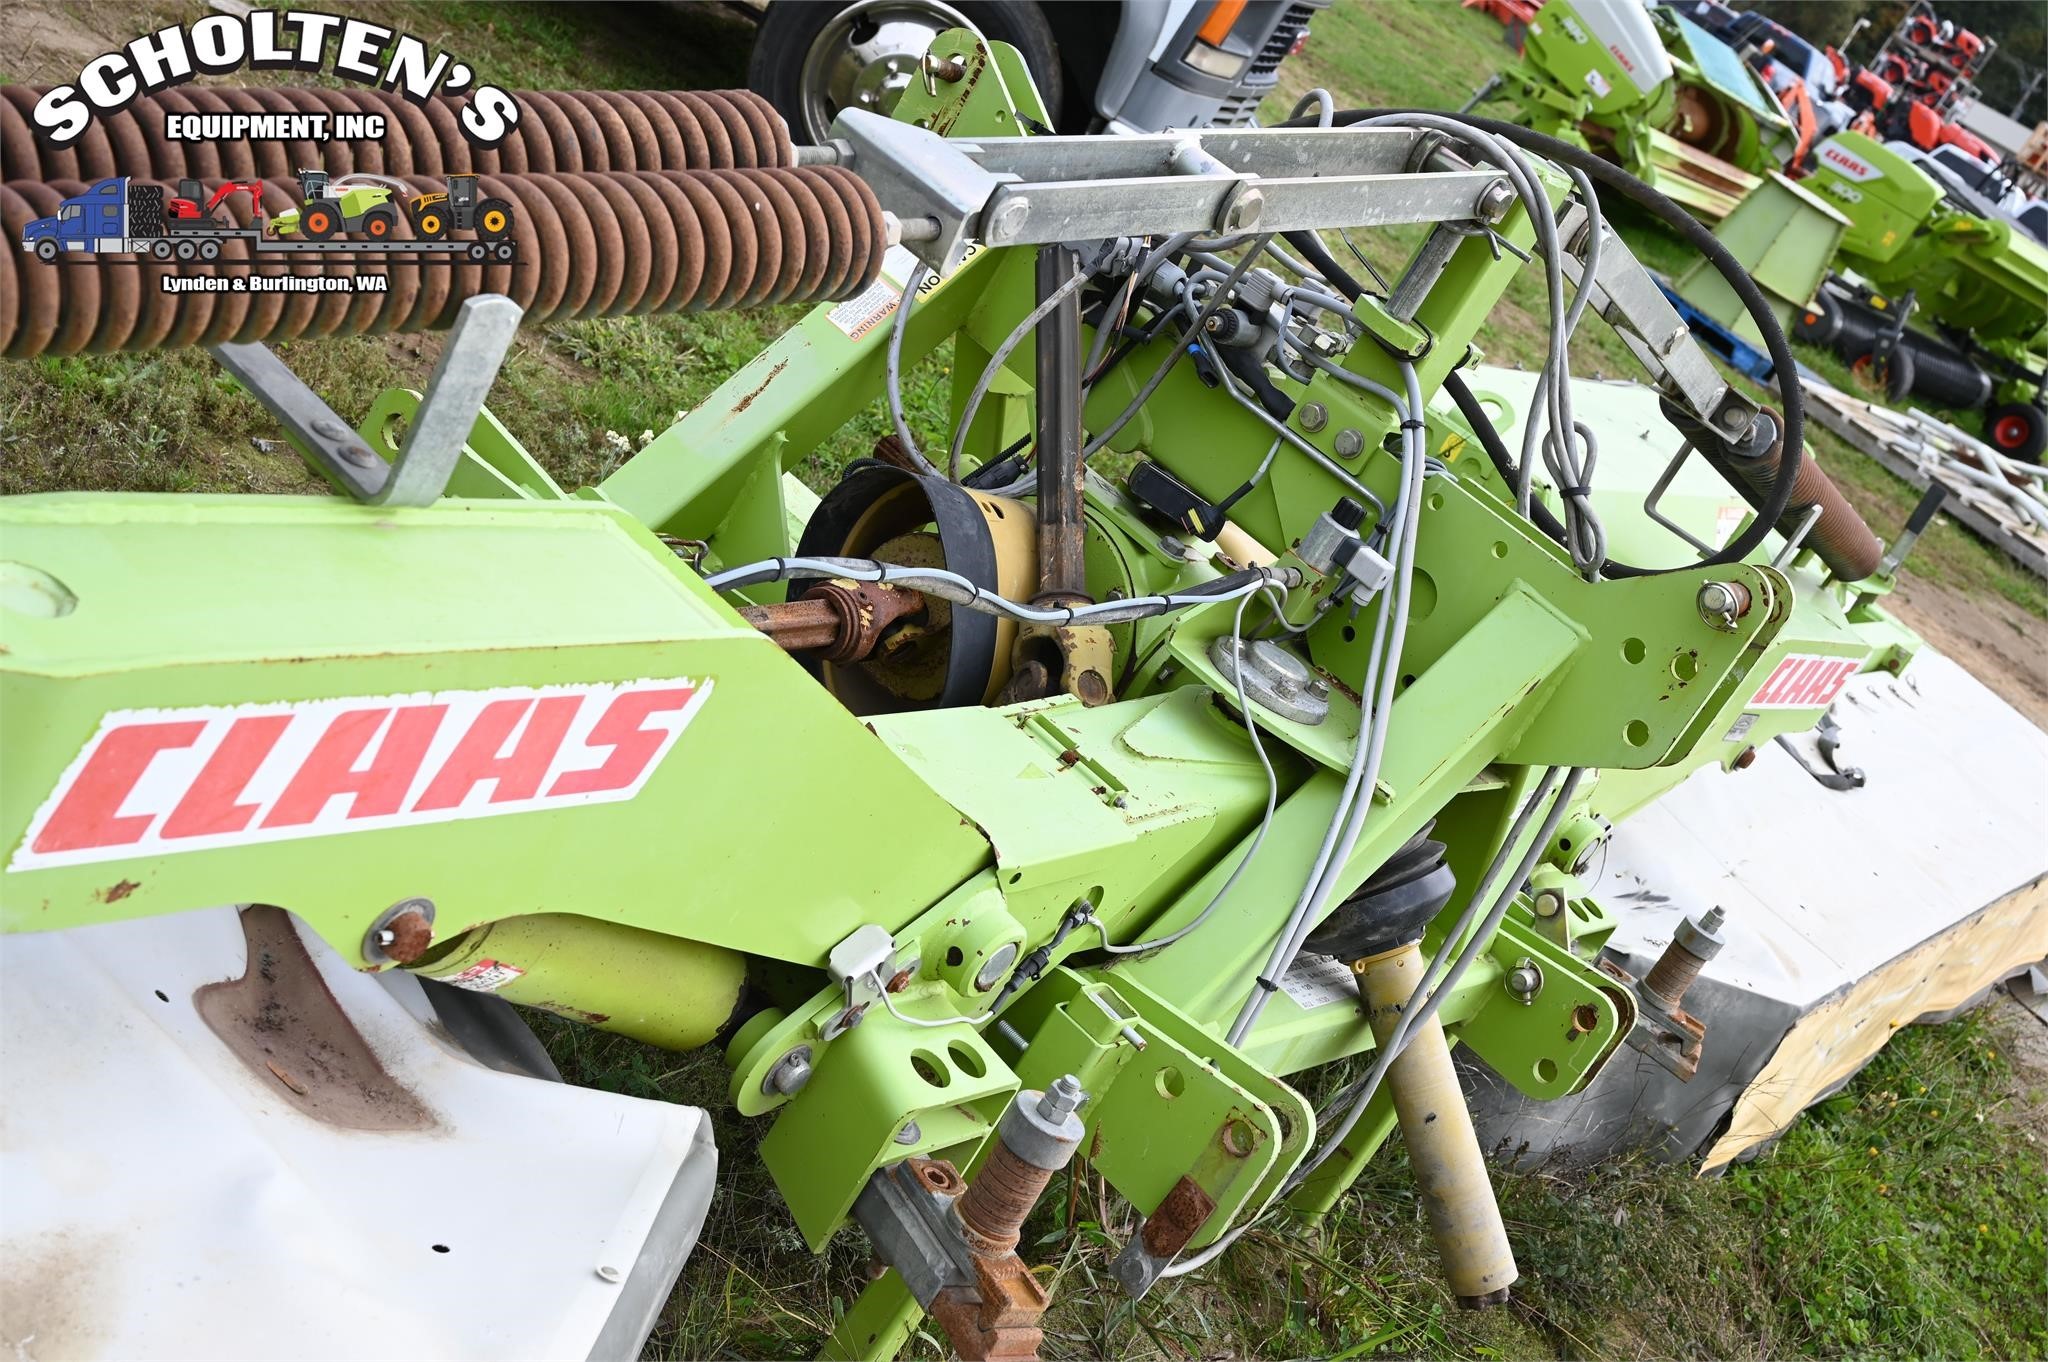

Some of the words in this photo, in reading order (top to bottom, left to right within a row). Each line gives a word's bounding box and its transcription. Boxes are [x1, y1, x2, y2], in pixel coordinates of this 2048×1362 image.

[1825, 148, 1868, 176] CLAAS
[849, 300, 898, 341] WARNING
[1750, 657, 1861, 705] CLAAS
[31, 687, 696, 855] CLAAS
